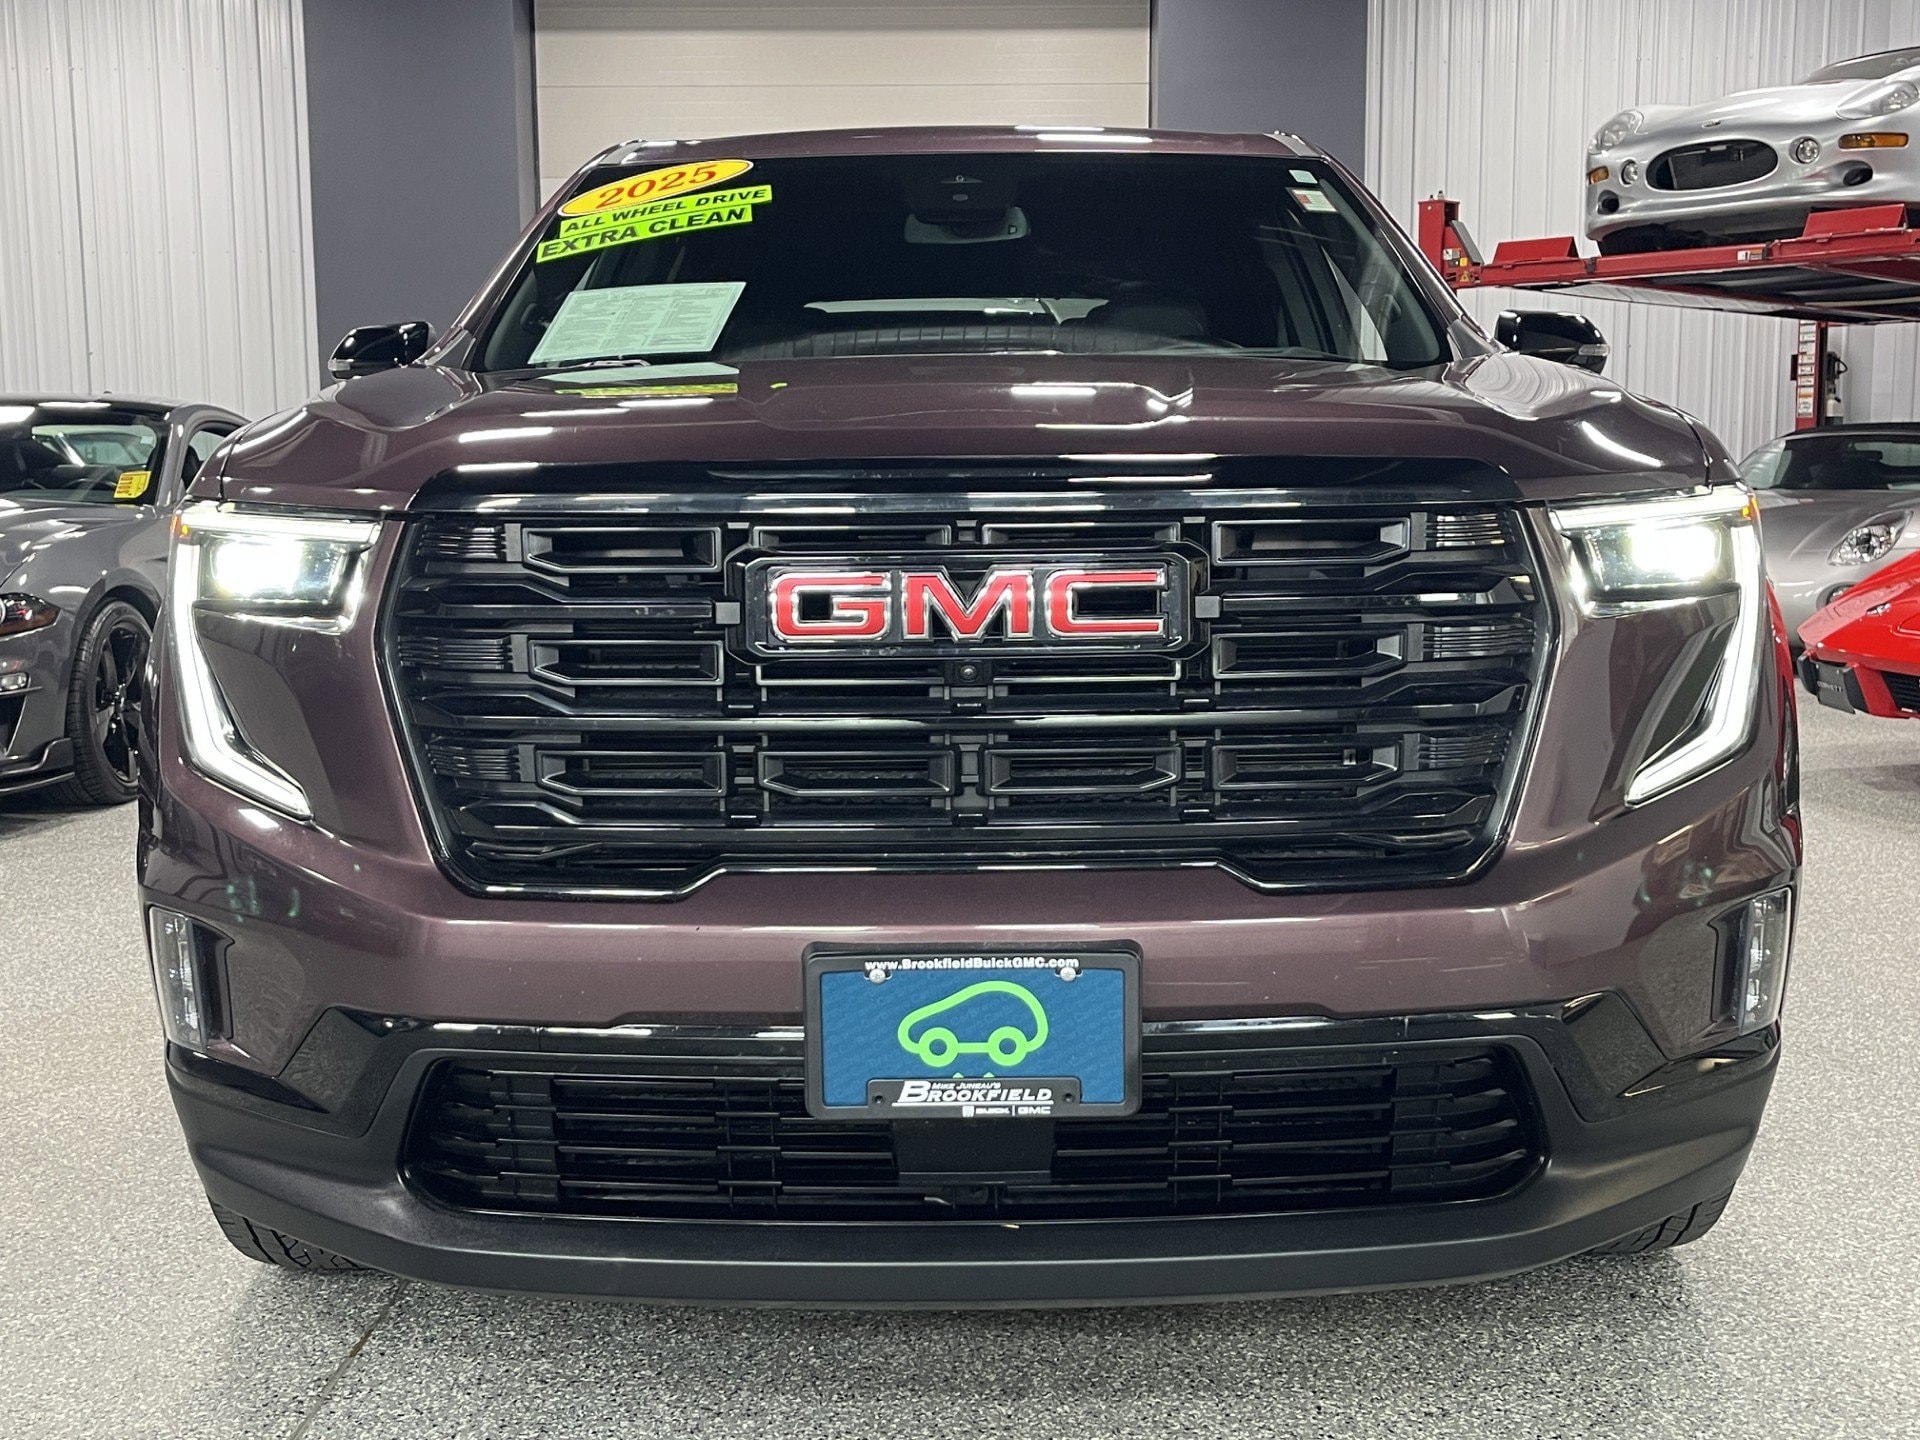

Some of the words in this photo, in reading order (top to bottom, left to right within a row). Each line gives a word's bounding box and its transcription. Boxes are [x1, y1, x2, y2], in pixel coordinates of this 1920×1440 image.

[595, 164, 718, 209] 2025
[541, 226, 637, 258] EXTRA
[648, 208, 746, 234] CLEAN
[564, 217, 605, 233] ALL
[612, 201, 687, 222] WHEEL
[695, 188, 768, 207] DRIVE
[769, 569, 1166, 643] GMC
[864, 957, 1080, 970] www.BrookfieldBuickGMC.com
[897, 1080, 1053, 1102] BROOKFIELD
[1018, 1106, 1051, 1115] GMC
